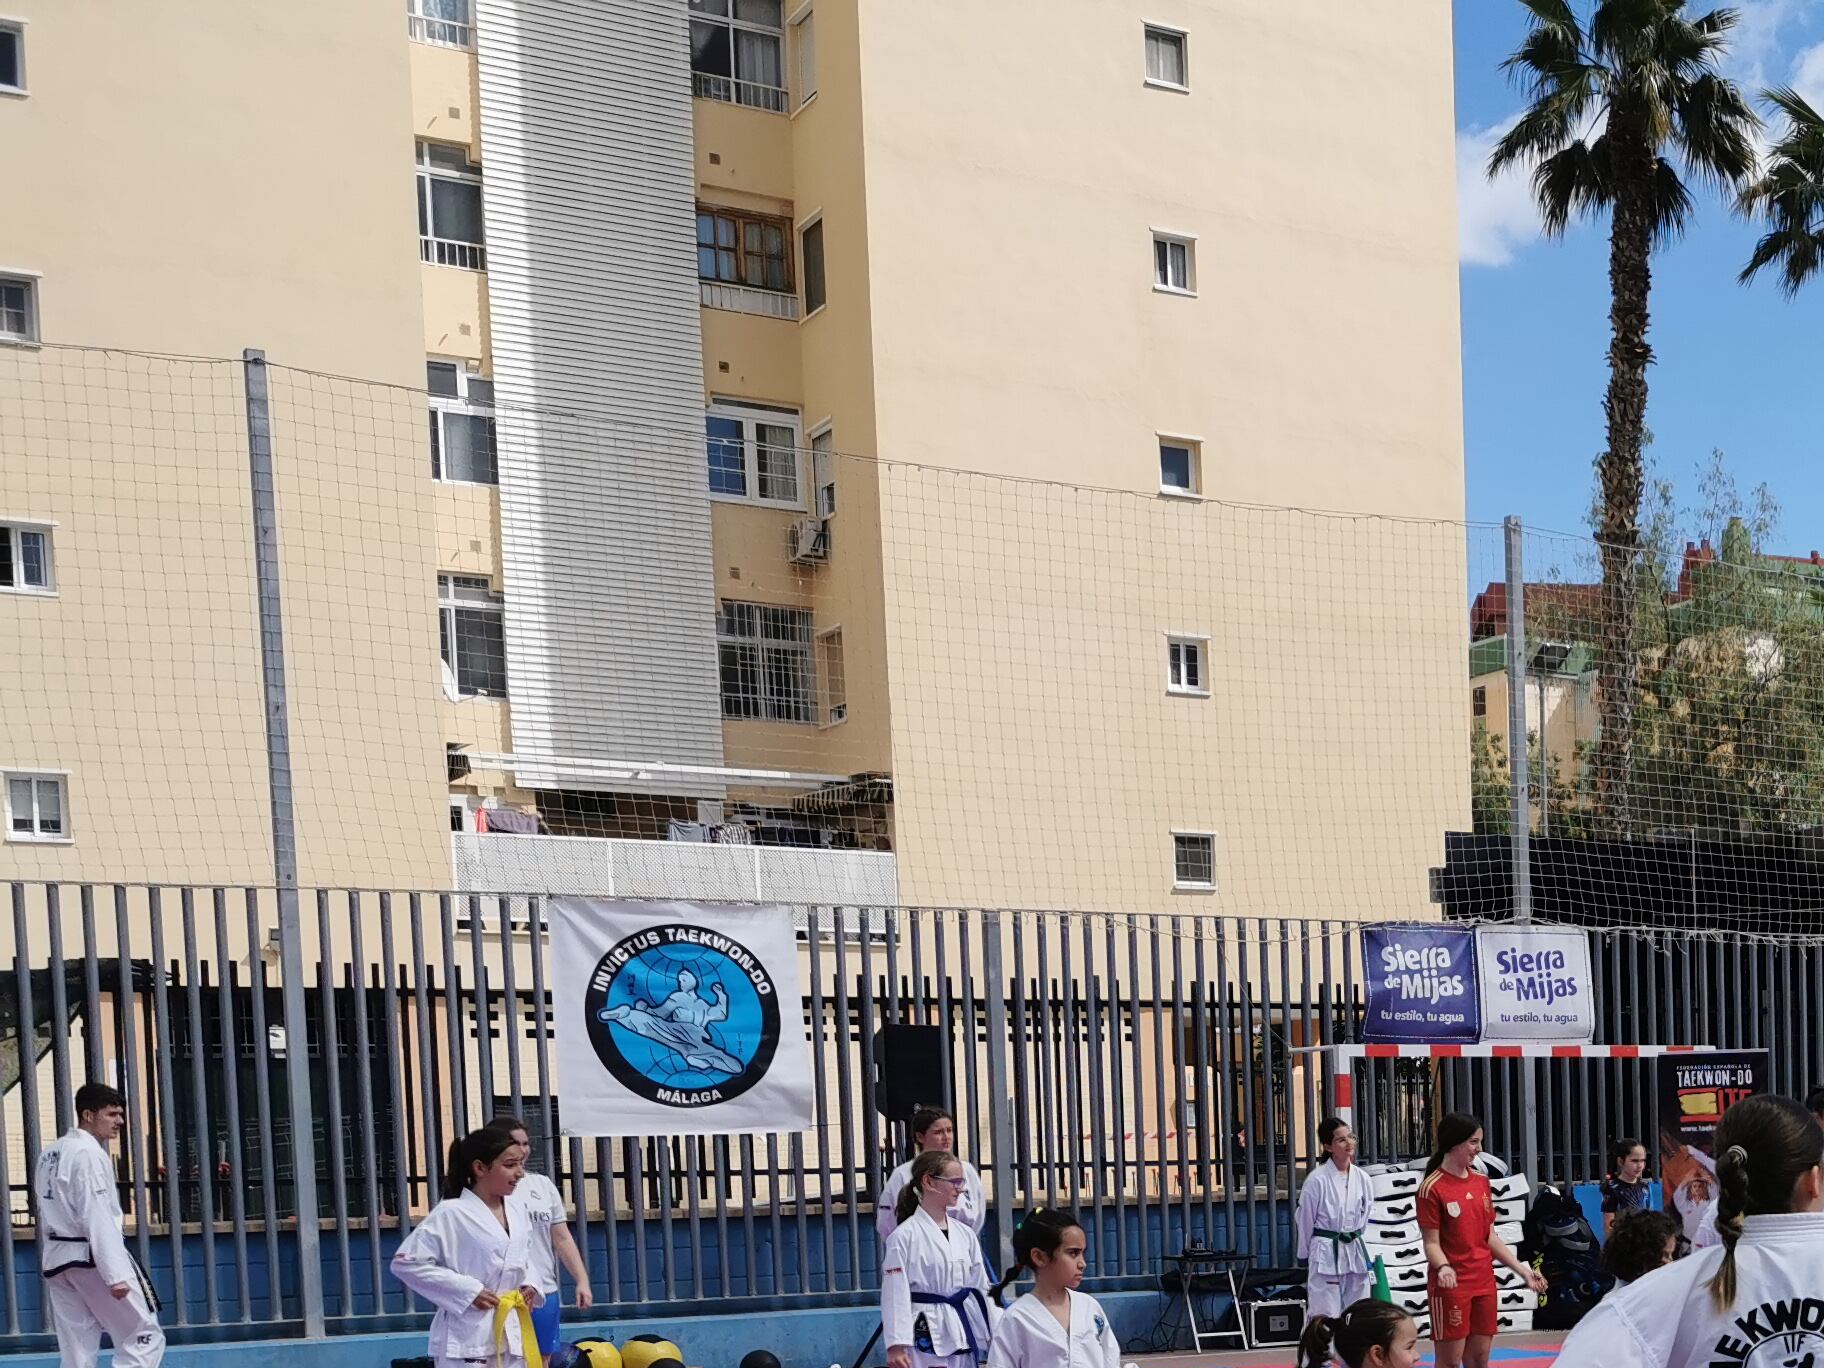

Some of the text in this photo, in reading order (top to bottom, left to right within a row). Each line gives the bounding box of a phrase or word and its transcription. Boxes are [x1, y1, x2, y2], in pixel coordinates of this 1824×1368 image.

[593, 928, 772, 995] INVICTUS TAEKWON-DO
[1381, 944, 1452, 973] Sierra
[1496, 947, 1565, 975] Sierra
[1384, 969, 1464, 1005] de Mijas
[1499, 973, 1578, 1005] de Mijas
[1381, 1009, 1465, 1025] tu estilo, tu agua
[1501, 1012, 1578, 1025] tu estilo, tu agua
[1677, 1069, 1753, 1088] TAEKWON-DO
[656, 1087, 722, 1104] MÁLAGA
